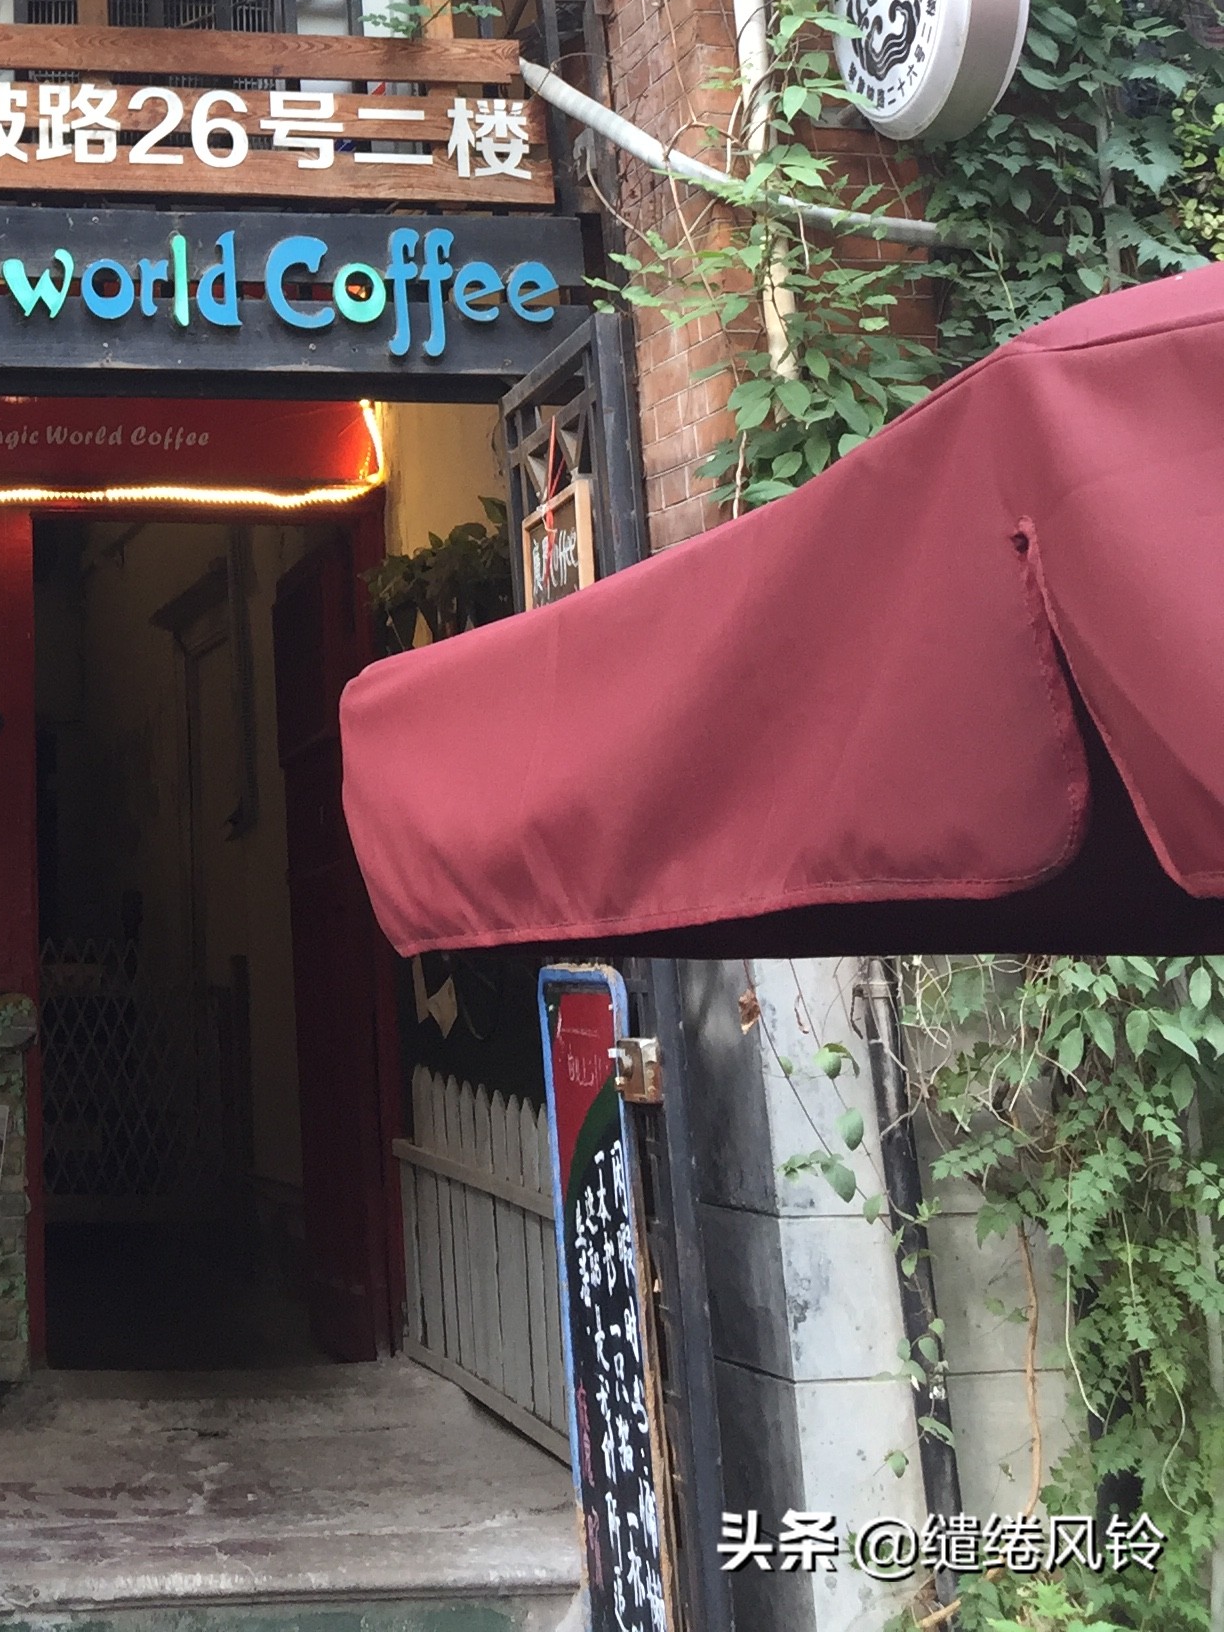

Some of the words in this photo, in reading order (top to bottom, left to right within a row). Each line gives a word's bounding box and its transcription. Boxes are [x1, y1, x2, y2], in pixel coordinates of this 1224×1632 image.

[265, 226, 559, 358] Coffee
[45, 425, 123, 446] World
[131, 425, 211, 451] Coffee
